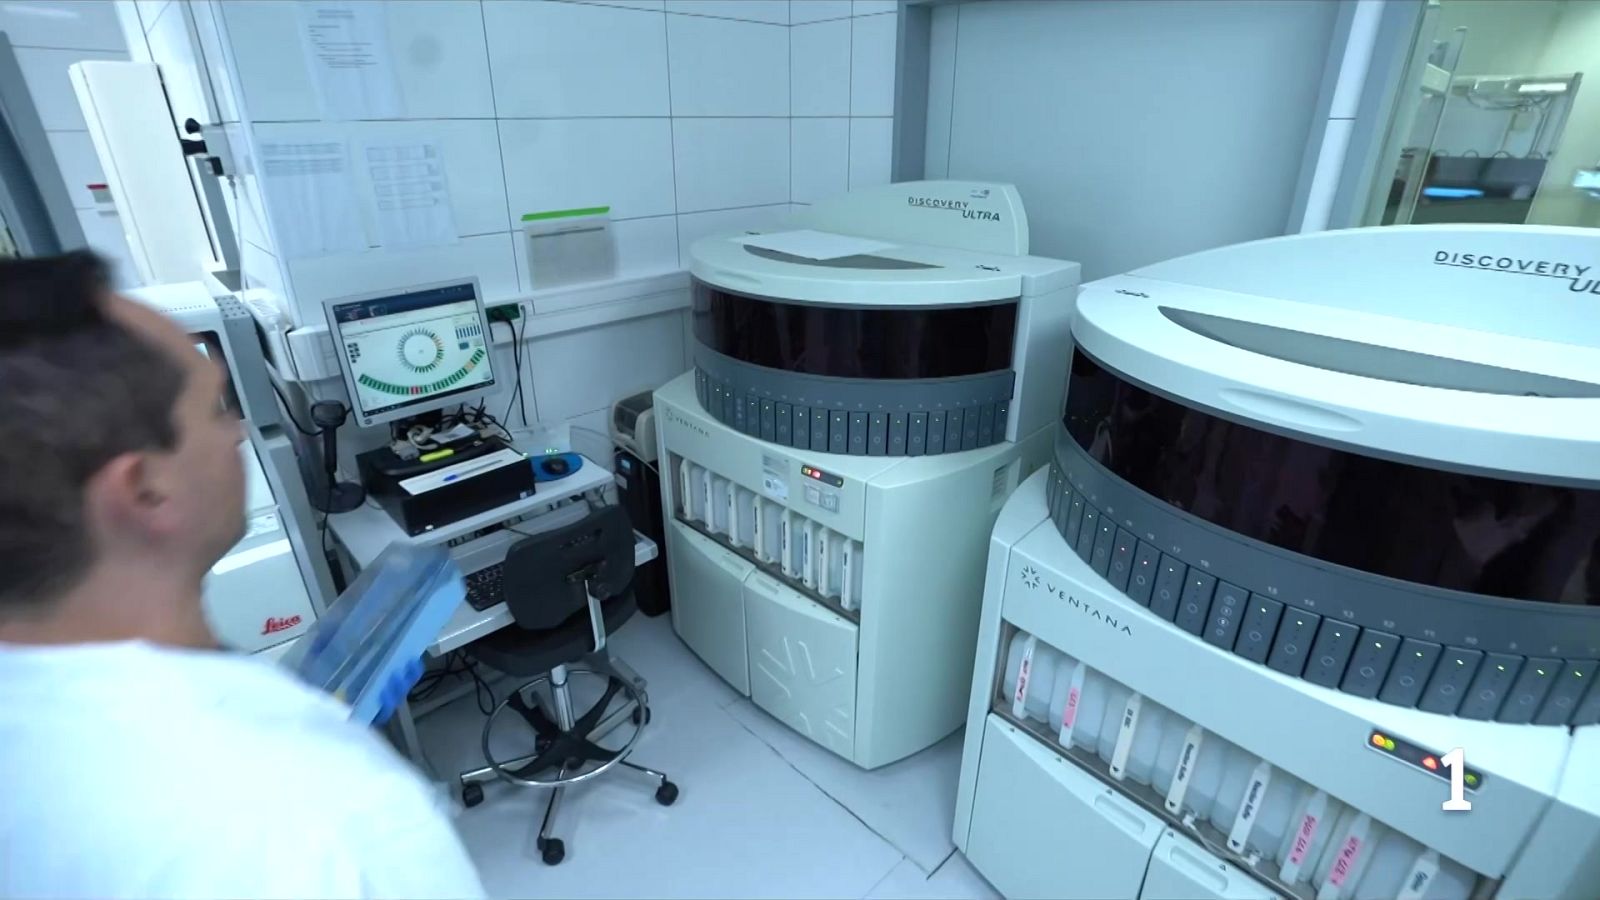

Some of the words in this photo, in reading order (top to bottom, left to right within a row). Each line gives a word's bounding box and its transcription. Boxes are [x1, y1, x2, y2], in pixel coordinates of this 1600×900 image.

[908, 196, 969, 209] DISCOVERY
[962, 209, 1000, 221] ULTRA
[1434, 250, 1592, 277] DISCOVERY
[1047, 583, 1132, 636] VENTANA
[261, 614, 302, 636] Leica
